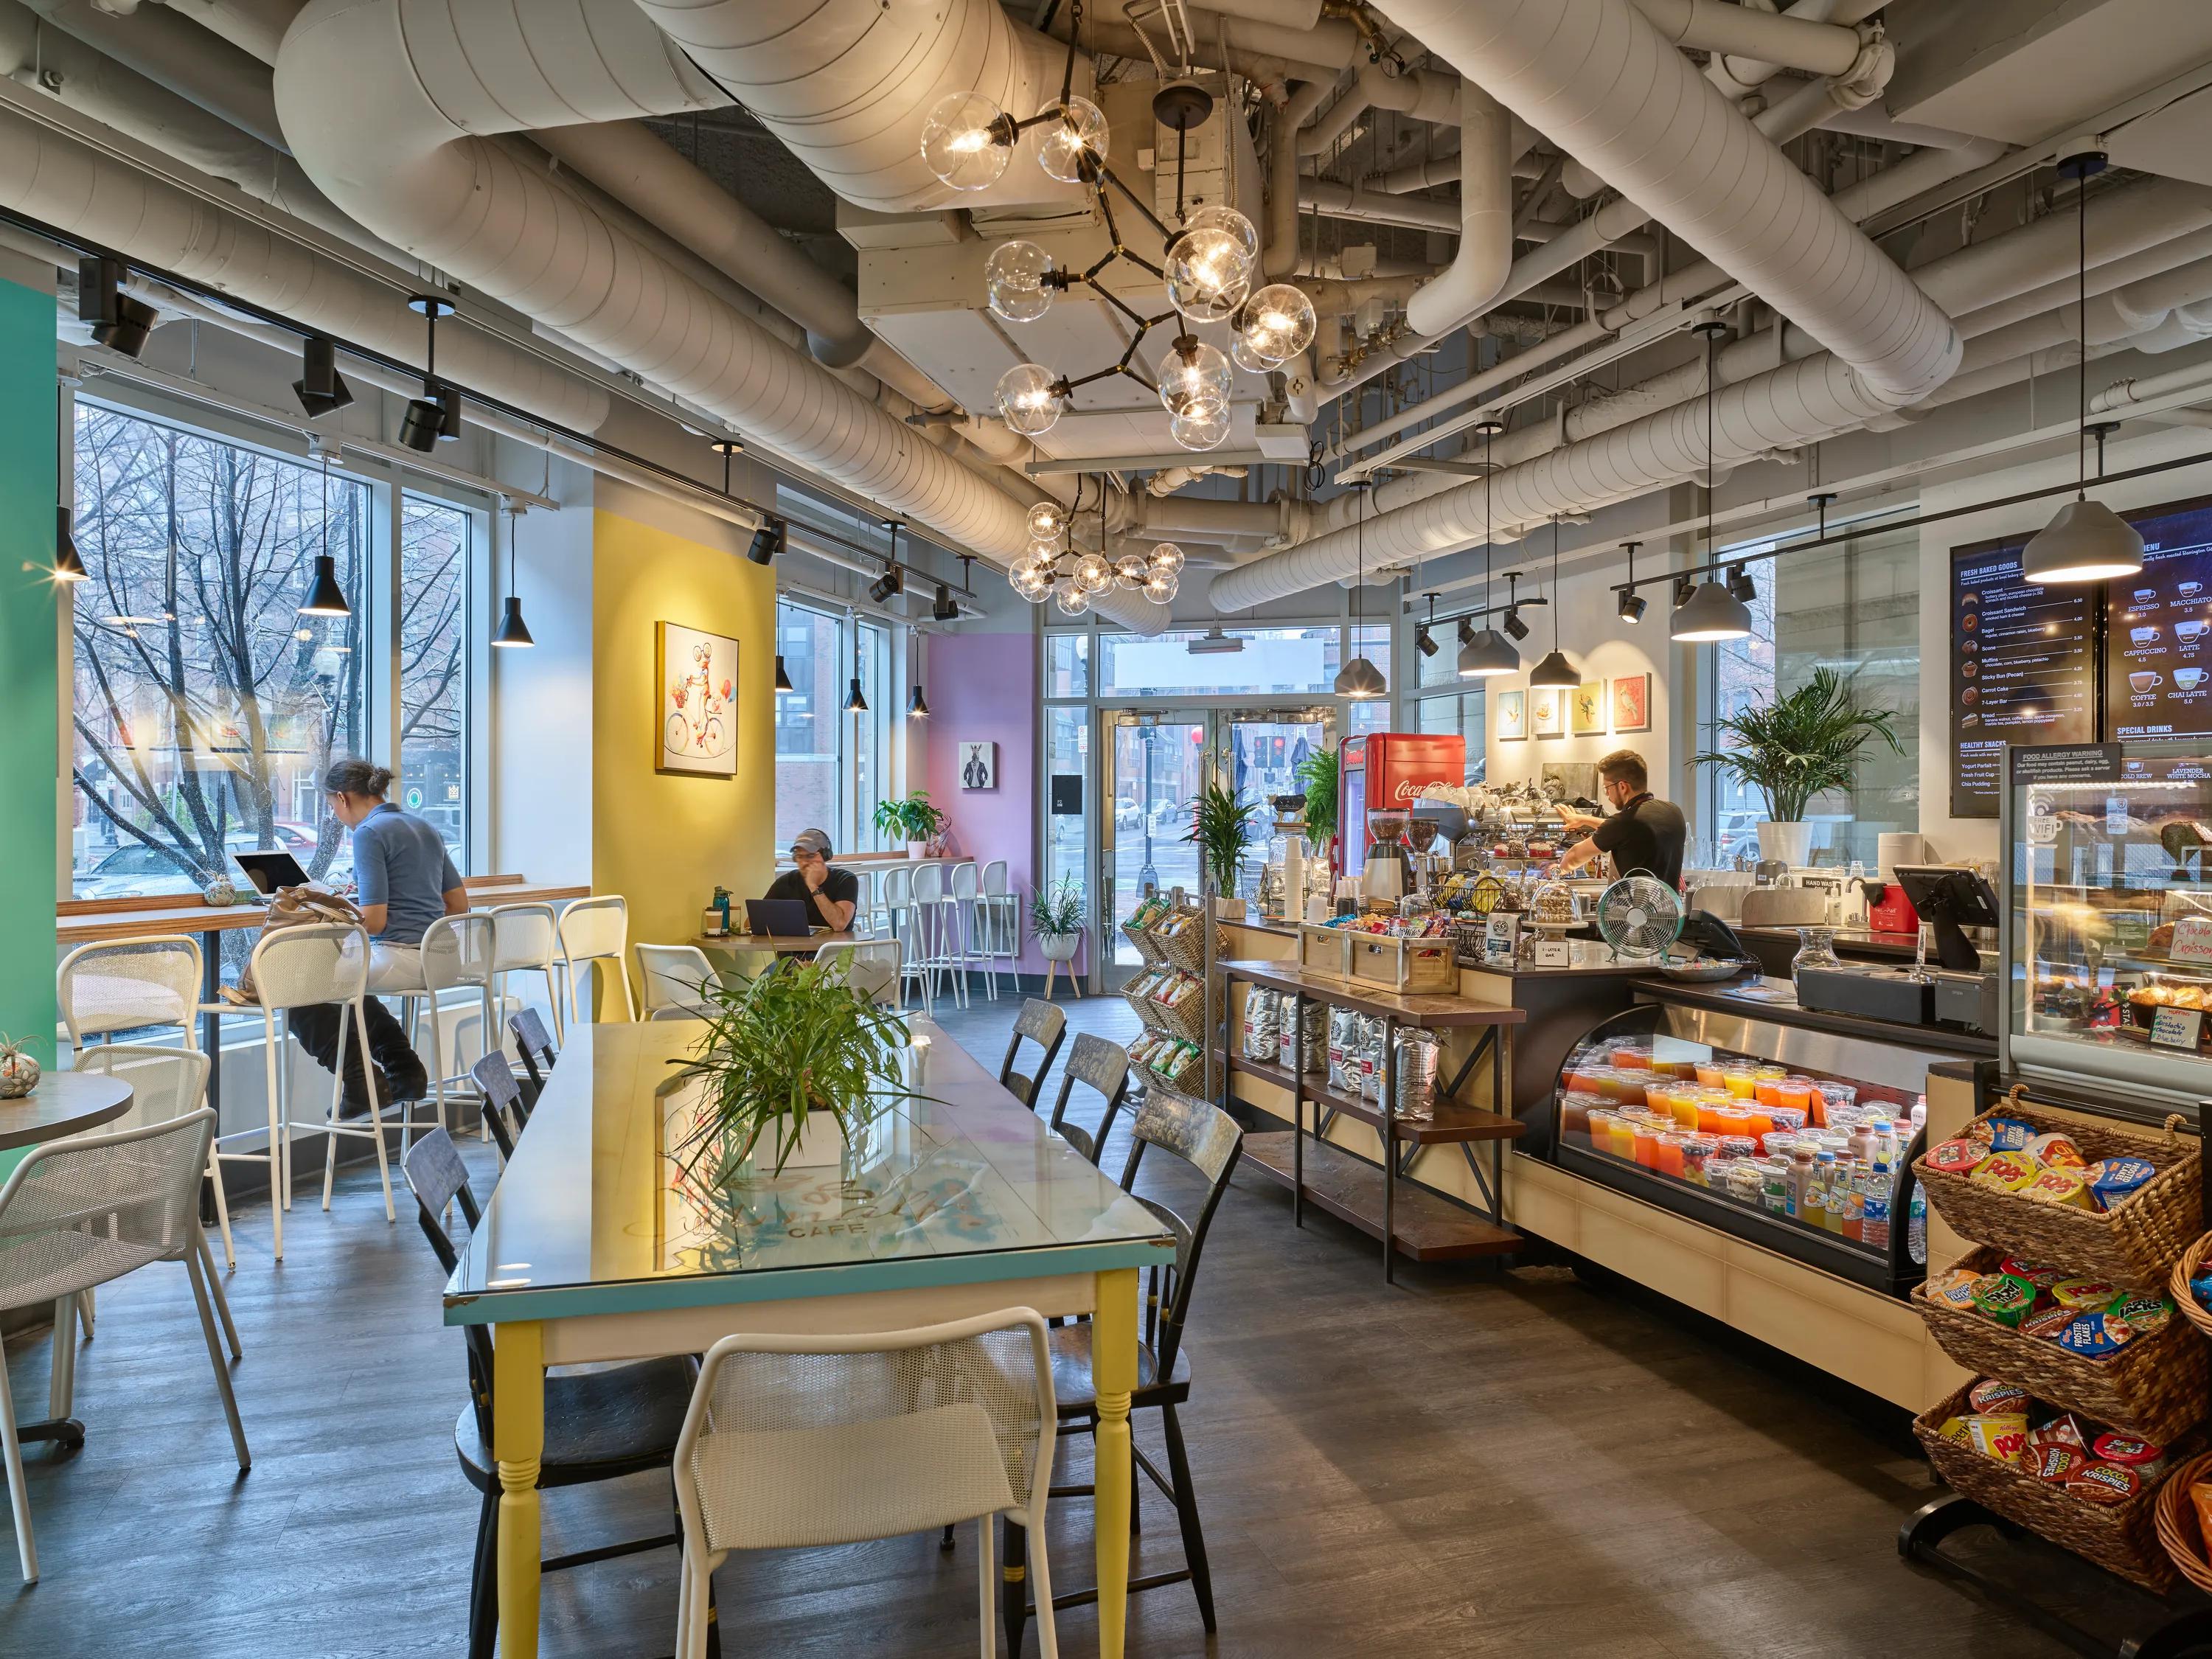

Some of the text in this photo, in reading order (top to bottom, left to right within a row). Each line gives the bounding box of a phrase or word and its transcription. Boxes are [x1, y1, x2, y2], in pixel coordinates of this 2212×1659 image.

[2143, 543, 2160, 552] ENU
[1961, 562, 2017, 577] FRESH BAKED GOODS
[2128, 603, 2159, 612] ESPRESSO
[2170, 597, 2212, 607] MACCHIATO
[2124, 647, 2166, 656] CAPPUCCINO
[2118, 725, 2172, 734] SPECIAL DRINKS
[2029, 824, 2054, 833] WIFI
[2007, 1125, 2016, 1144] FLAKES
[2014, 1125, 2025, 1146] FROSTED
[2115, 1163, 2132, 1180] FLAKES
[2122, 1162, 2141, 1183] FROSTED
[787, 1222, 867, 1239] CAFE
[1983, 1278, 2022, 1303] JACKS
[2029, 1310, 2063, 1322] COCOA
[2119, 1301, 2163, 1318] JACKS
[2025, 1310, 2070, 1328] KRISPIES
[2073, 1322, 2084, 1348] FROSTED
[2082, 1324, 2092, 1345] FLAKES
[1978, 1388, 2023, 1404] KRISPIES
[1982, 1385, 2014, 1395] COCOA
[2042, 1448, 2060, 1477] KRISPIES
[2054, 1453, 2070, 1475] COCOA
[2081, 1470, 2131, 1491] KRISPIES
[2095, 1467, 2129, 1484] COCOA
